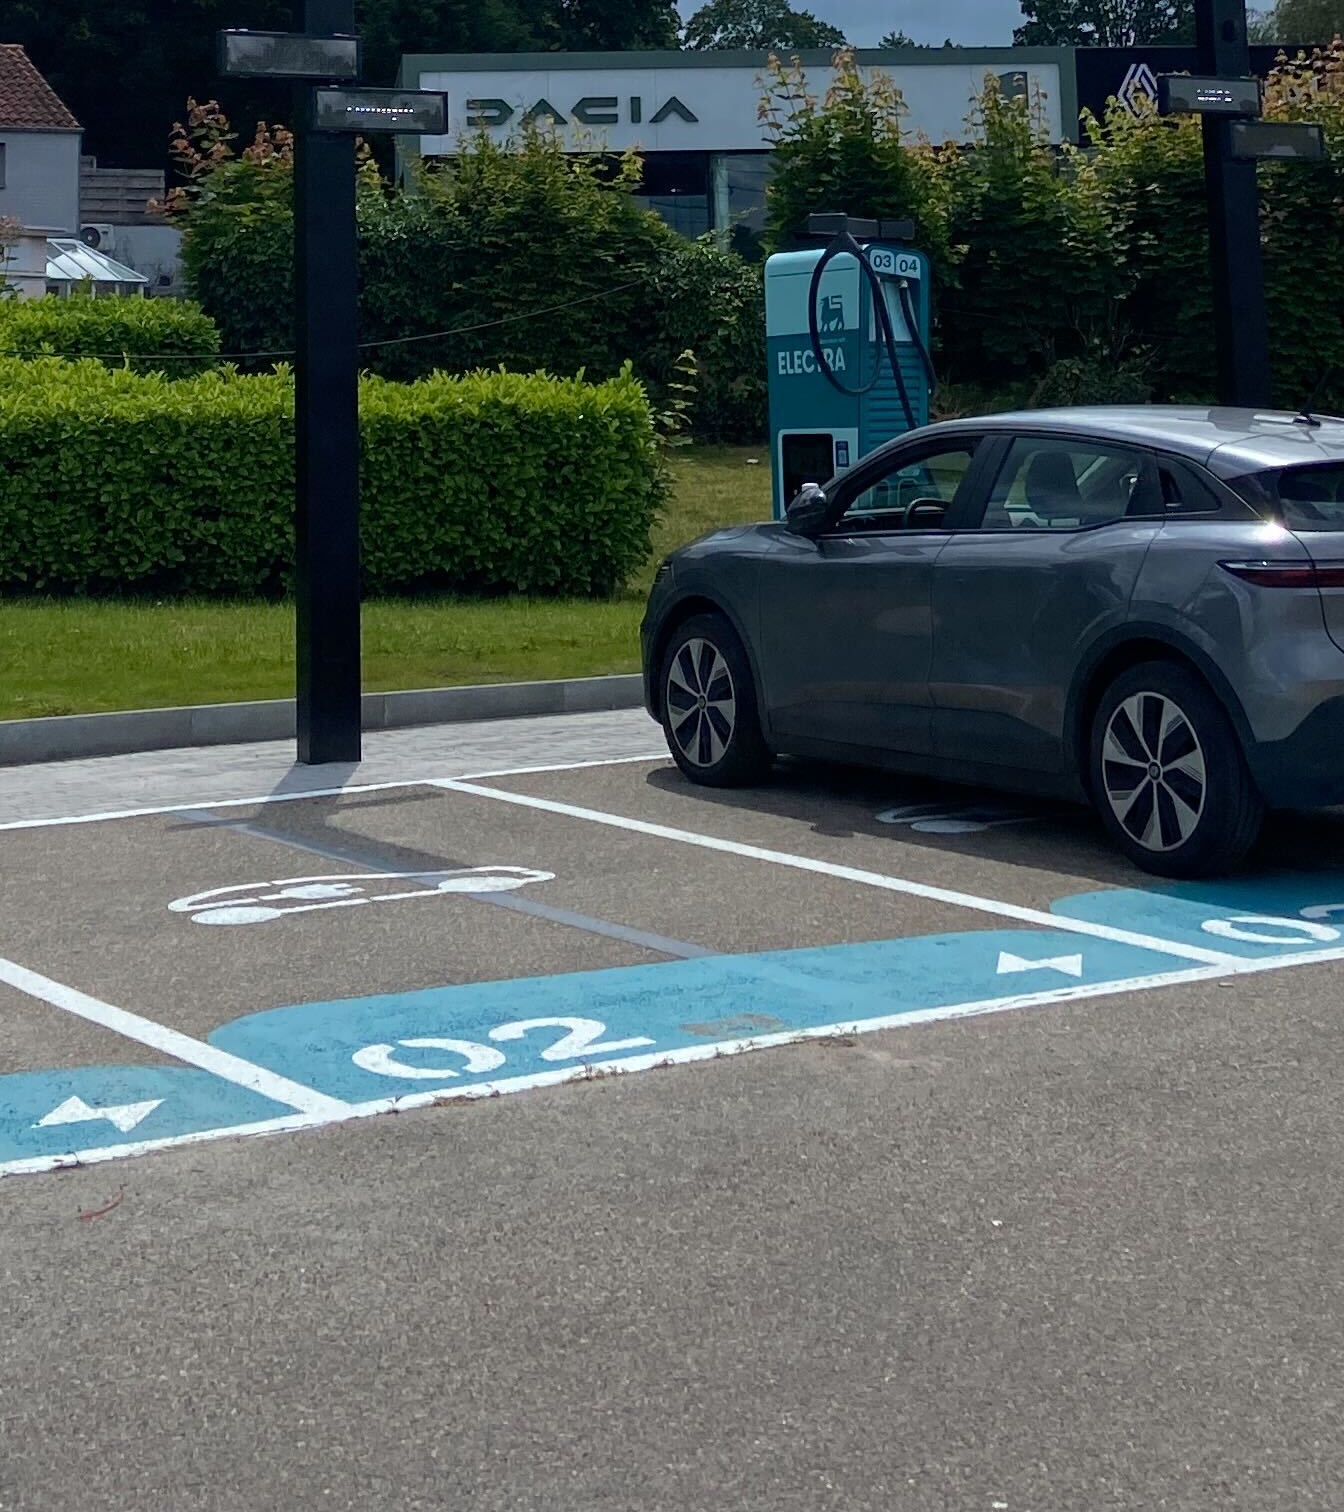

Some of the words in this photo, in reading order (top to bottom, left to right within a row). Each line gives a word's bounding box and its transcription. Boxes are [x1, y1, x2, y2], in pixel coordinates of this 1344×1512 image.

[465, 95, 700, 127] DACIA
[873, 254, 892, 269] 03
[899, 259, 918, 274] 04
[777, 345, 847, 375] ELECRA
[352, 1016, 657, 1080] 02
